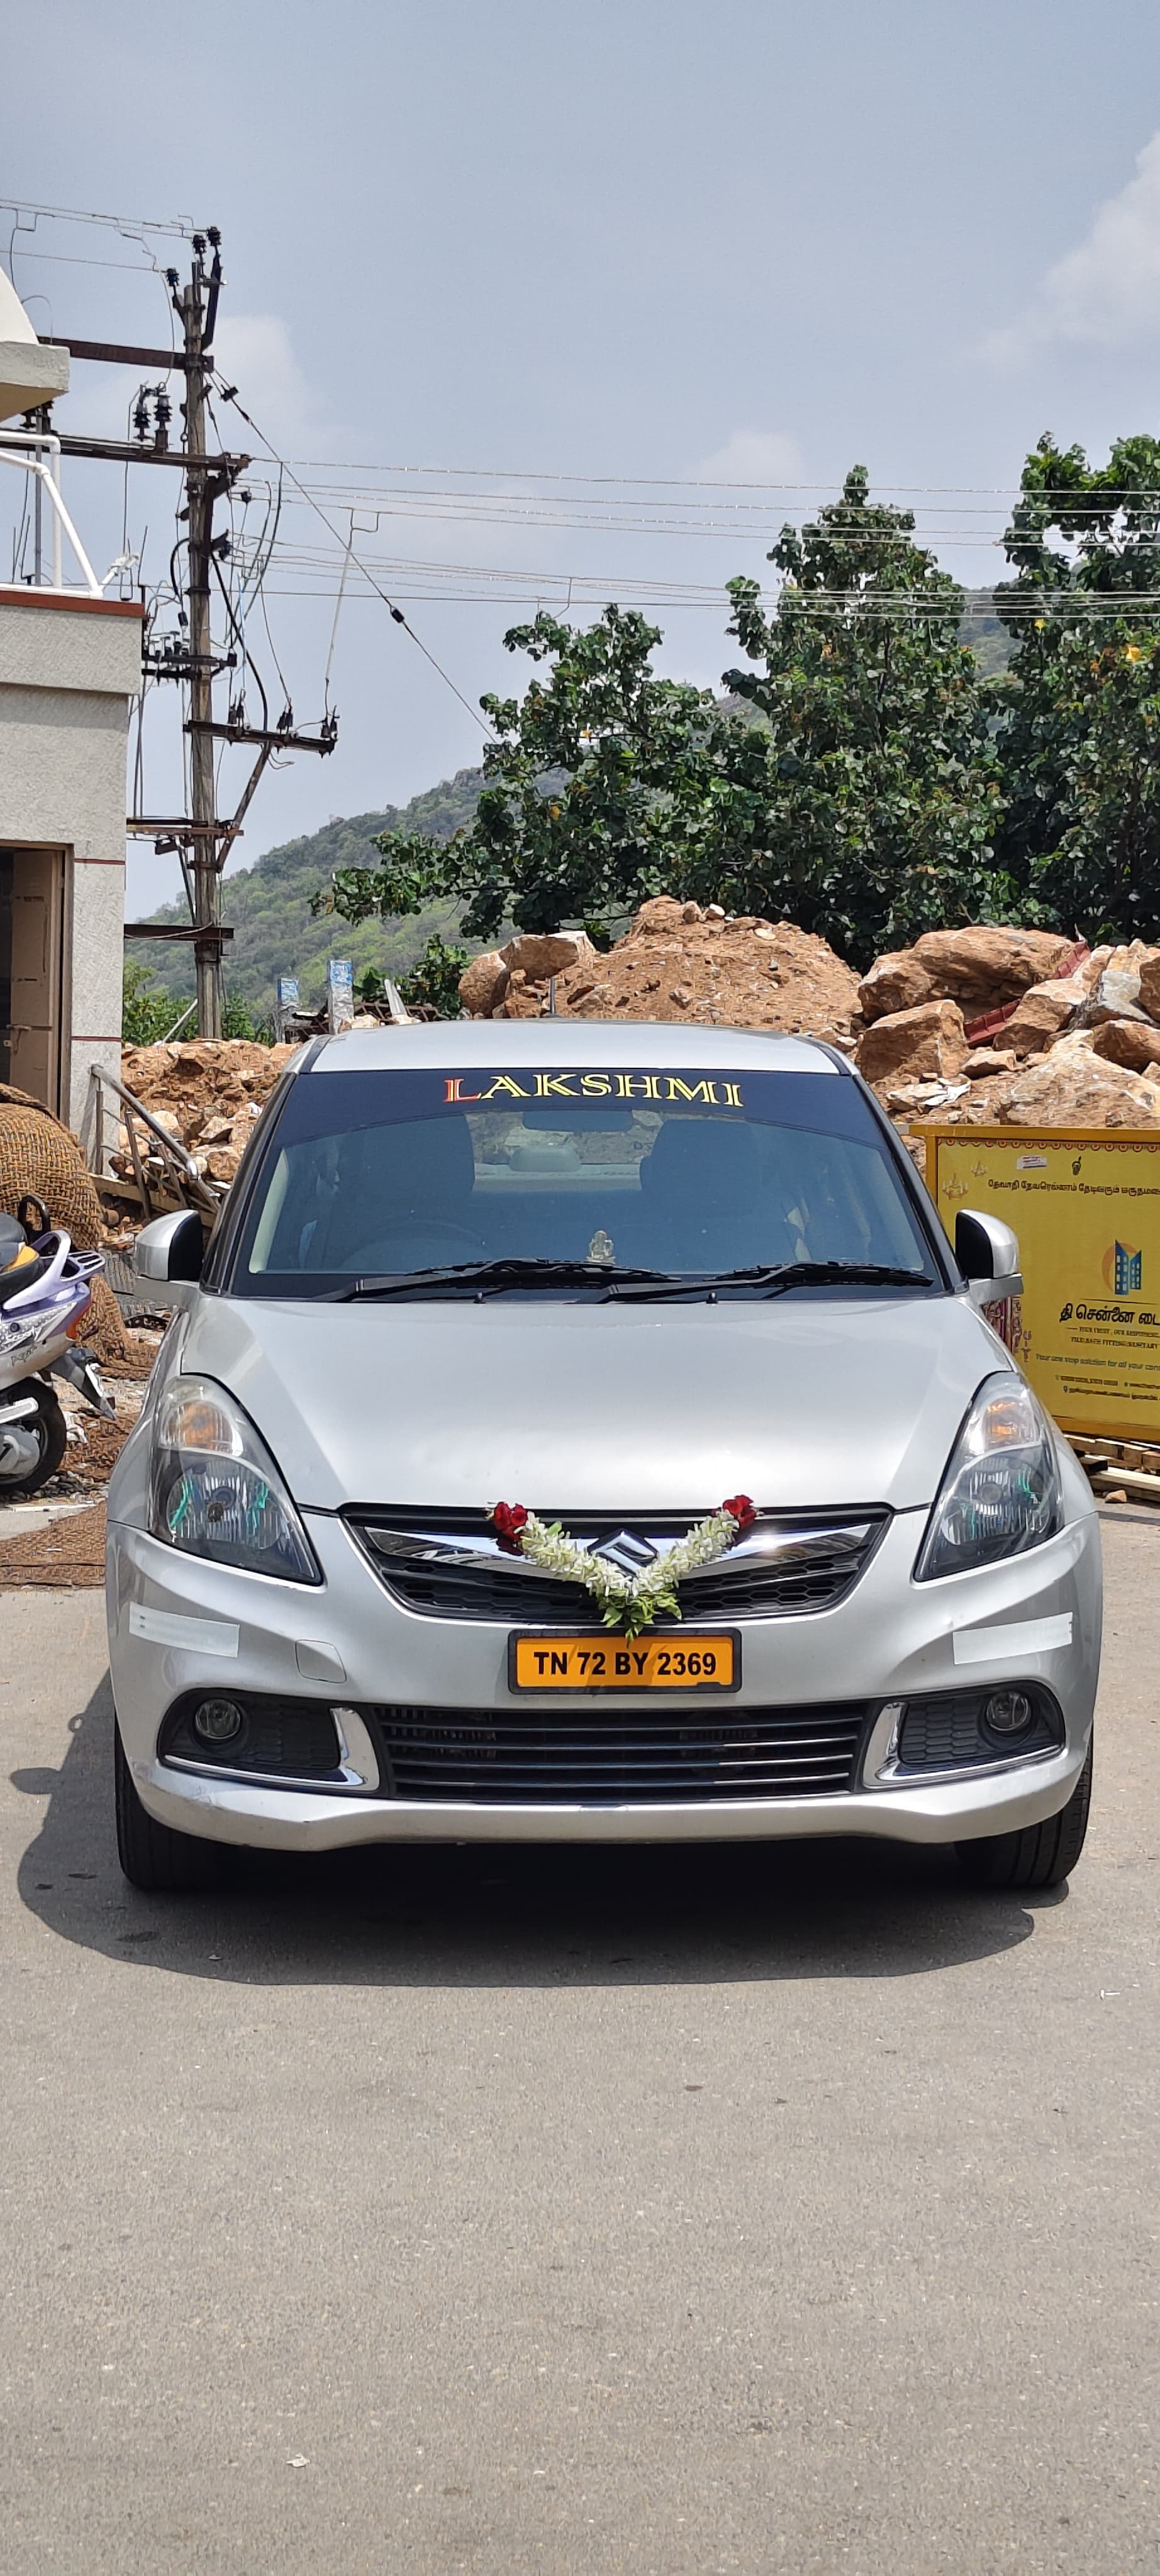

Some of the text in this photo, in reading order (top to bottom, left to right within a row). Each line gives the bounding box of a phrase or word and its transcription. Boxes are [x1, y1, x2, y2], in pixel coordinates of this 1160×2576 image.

[443, 1074, 744, 1107] LAKSHMI
[1059, 1302, 1073, 1323] தி
[1076, 1304, 1135, 1323] சென்னை
[534, 1652, 717, 1675] TN 72 BY 2369
